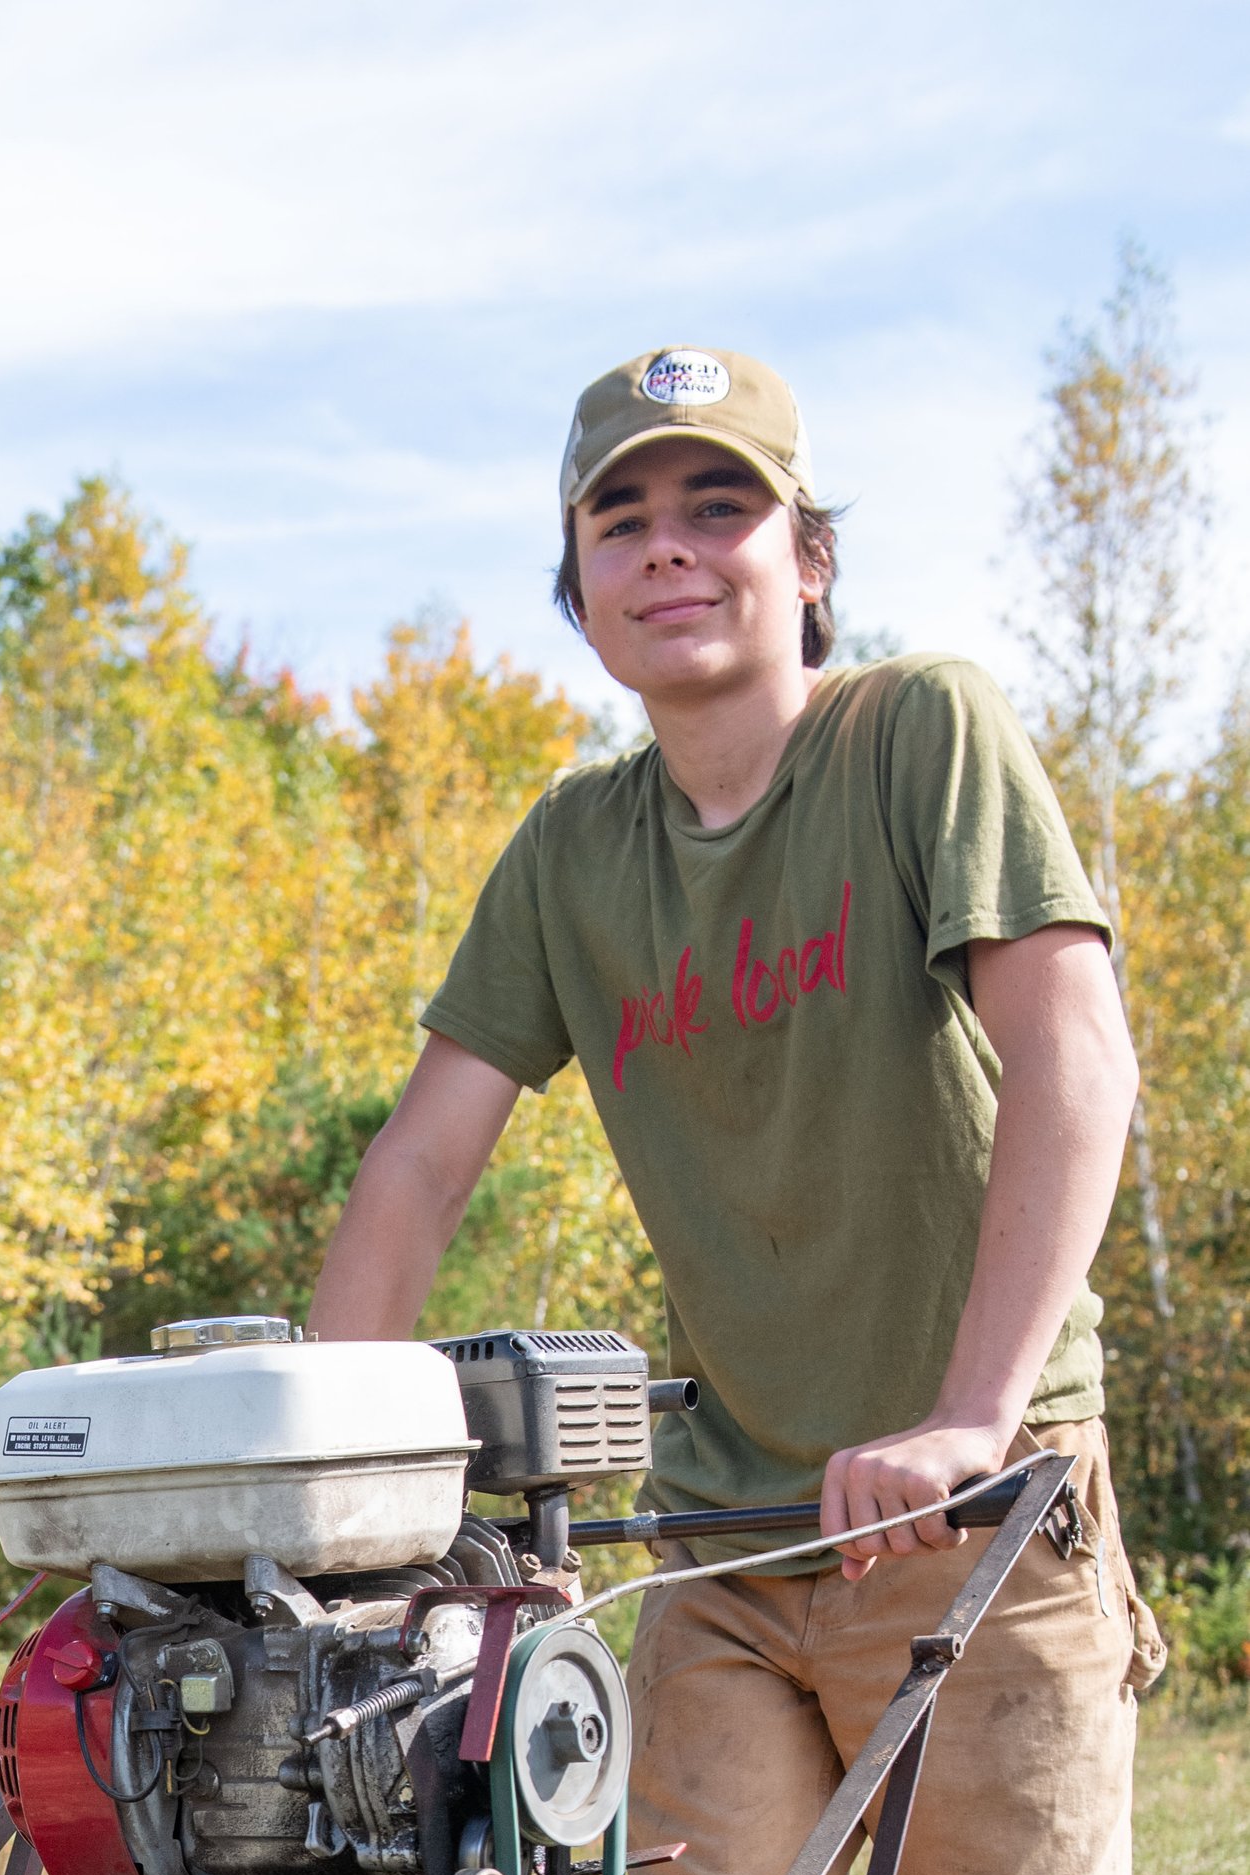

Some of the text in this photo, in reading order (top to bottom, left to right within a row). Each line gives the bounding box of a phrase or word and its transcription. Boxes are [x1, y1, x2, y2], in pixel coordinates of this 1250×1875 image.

[670, 382, 715, 394] FARM
[612, 880, 852, 1093] pick local
